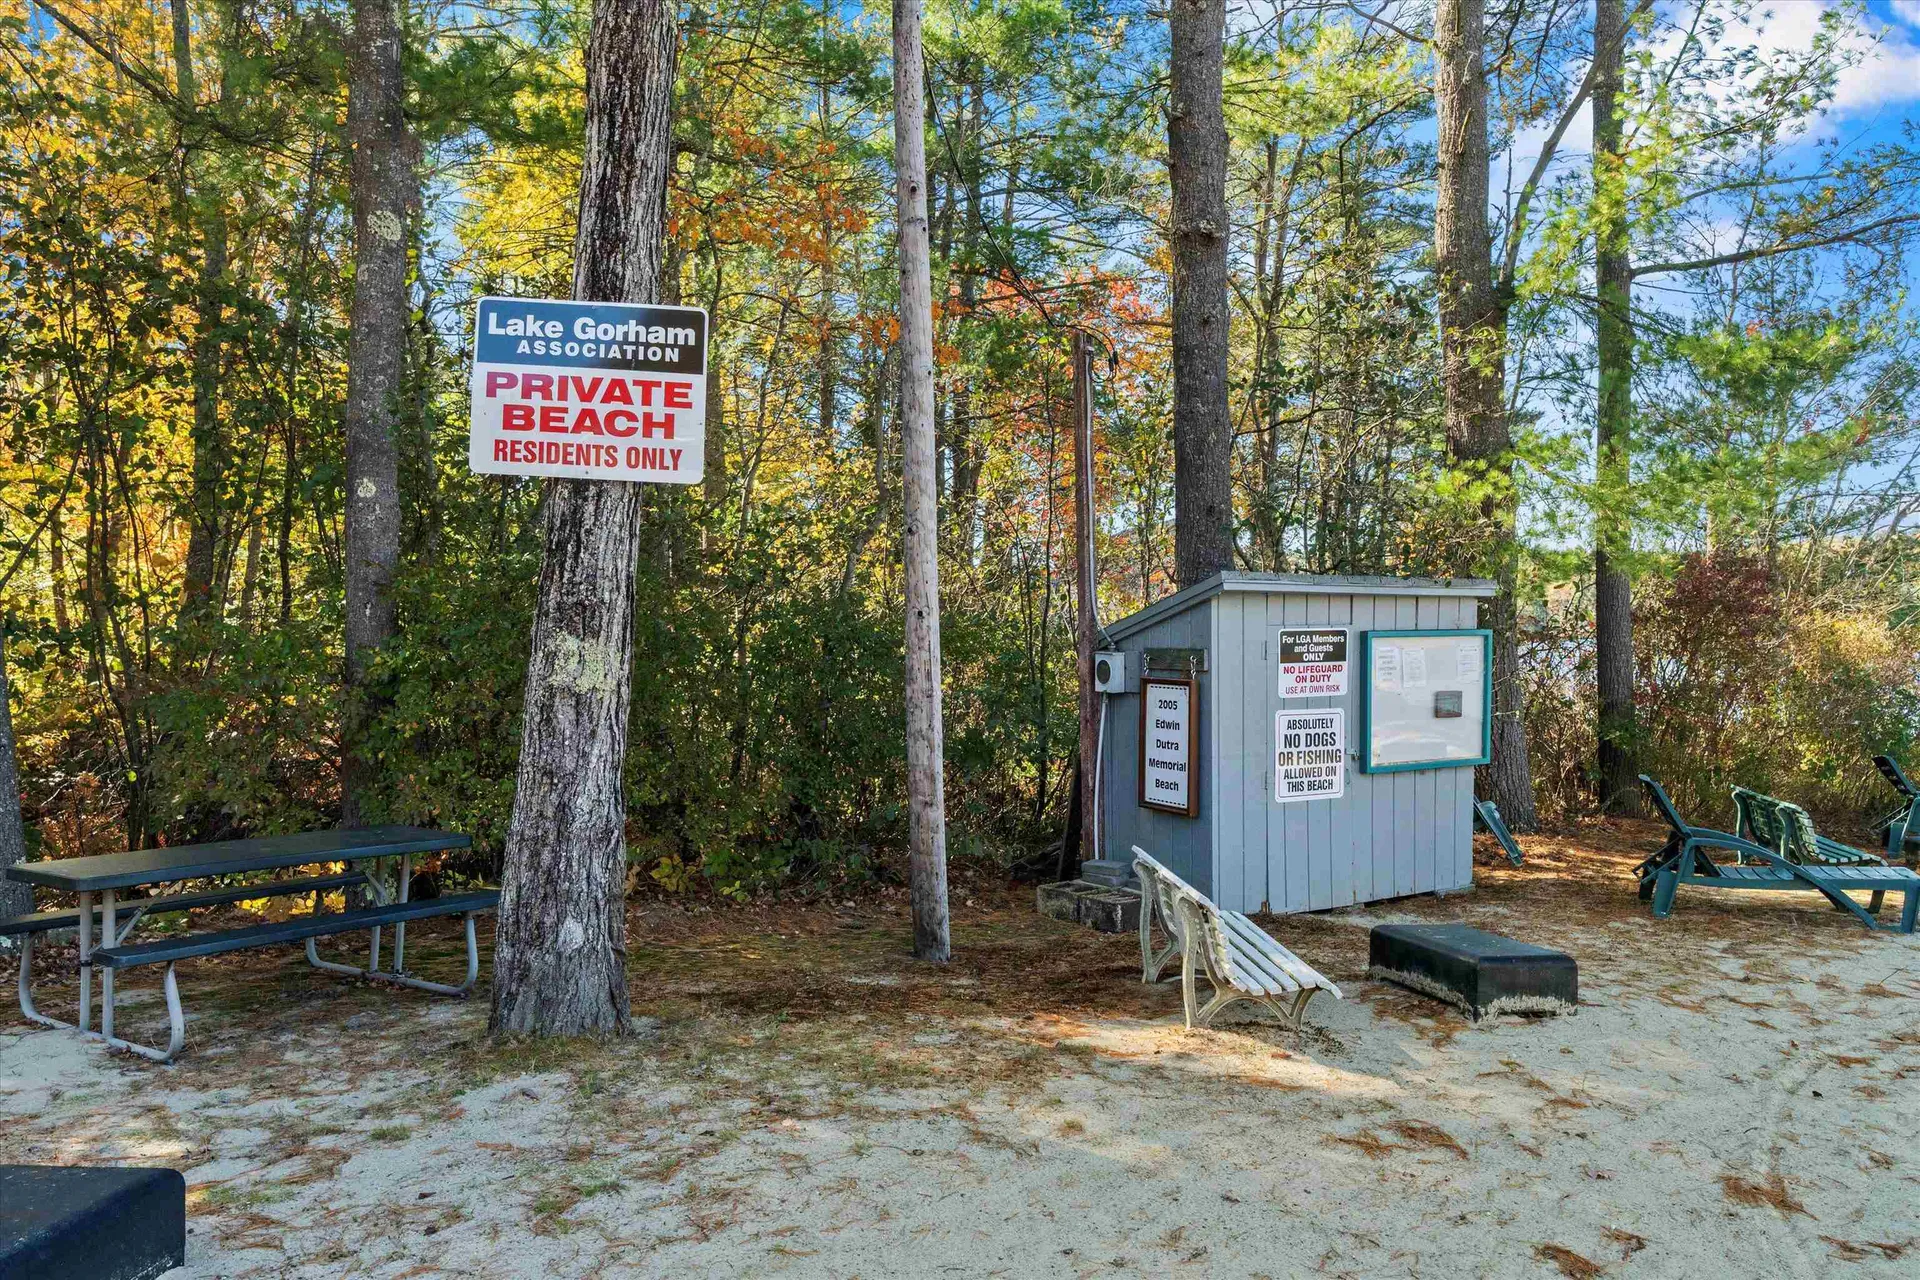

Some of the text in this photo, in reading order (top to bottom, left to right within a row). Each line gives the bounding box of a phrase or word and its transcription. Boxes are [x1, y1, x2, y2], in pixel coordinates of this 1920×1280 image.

[488, 312, 696, 346] Lake Gorham
[517, 339, 680, 363] ASSOCIATION
[485, 371, 693, 409] PRIVATE
[502, 404, 676, 440] BEACH
[493, 439, 683, 471] RESIDENTS ONLY
[1282, 634, 1345, 644] For LGA Members
[1294, 643, 1333, 653] and Guests
[1303, 652, 1324, 661] ONLY
[1283, 664, 1343, 674] NO LIFEGUARD
[1295, 674, 1331, 683] ON DUTY
[1285, 684, 1340, 694] USE AT OWN RISK
[1158, 699, 1178, 711] 2005
[1155, 719, 1180, 730] Edwin
[1287, 718, 1334, 730] ABSOLUTELY
[1156, 739, 1179, 751] Dutra
[1284, 731, 1336, 748] NO DOGS
[1278, 748, 1341, 766] OR FISHING
[1148, 758, 1186, 772] Memorial
[1284, 766, 1336, 780] ALLOWED ON
[1155, 778, 1179, 791] Beach
[1287, 779, 1333, 793] THIS BEACH
